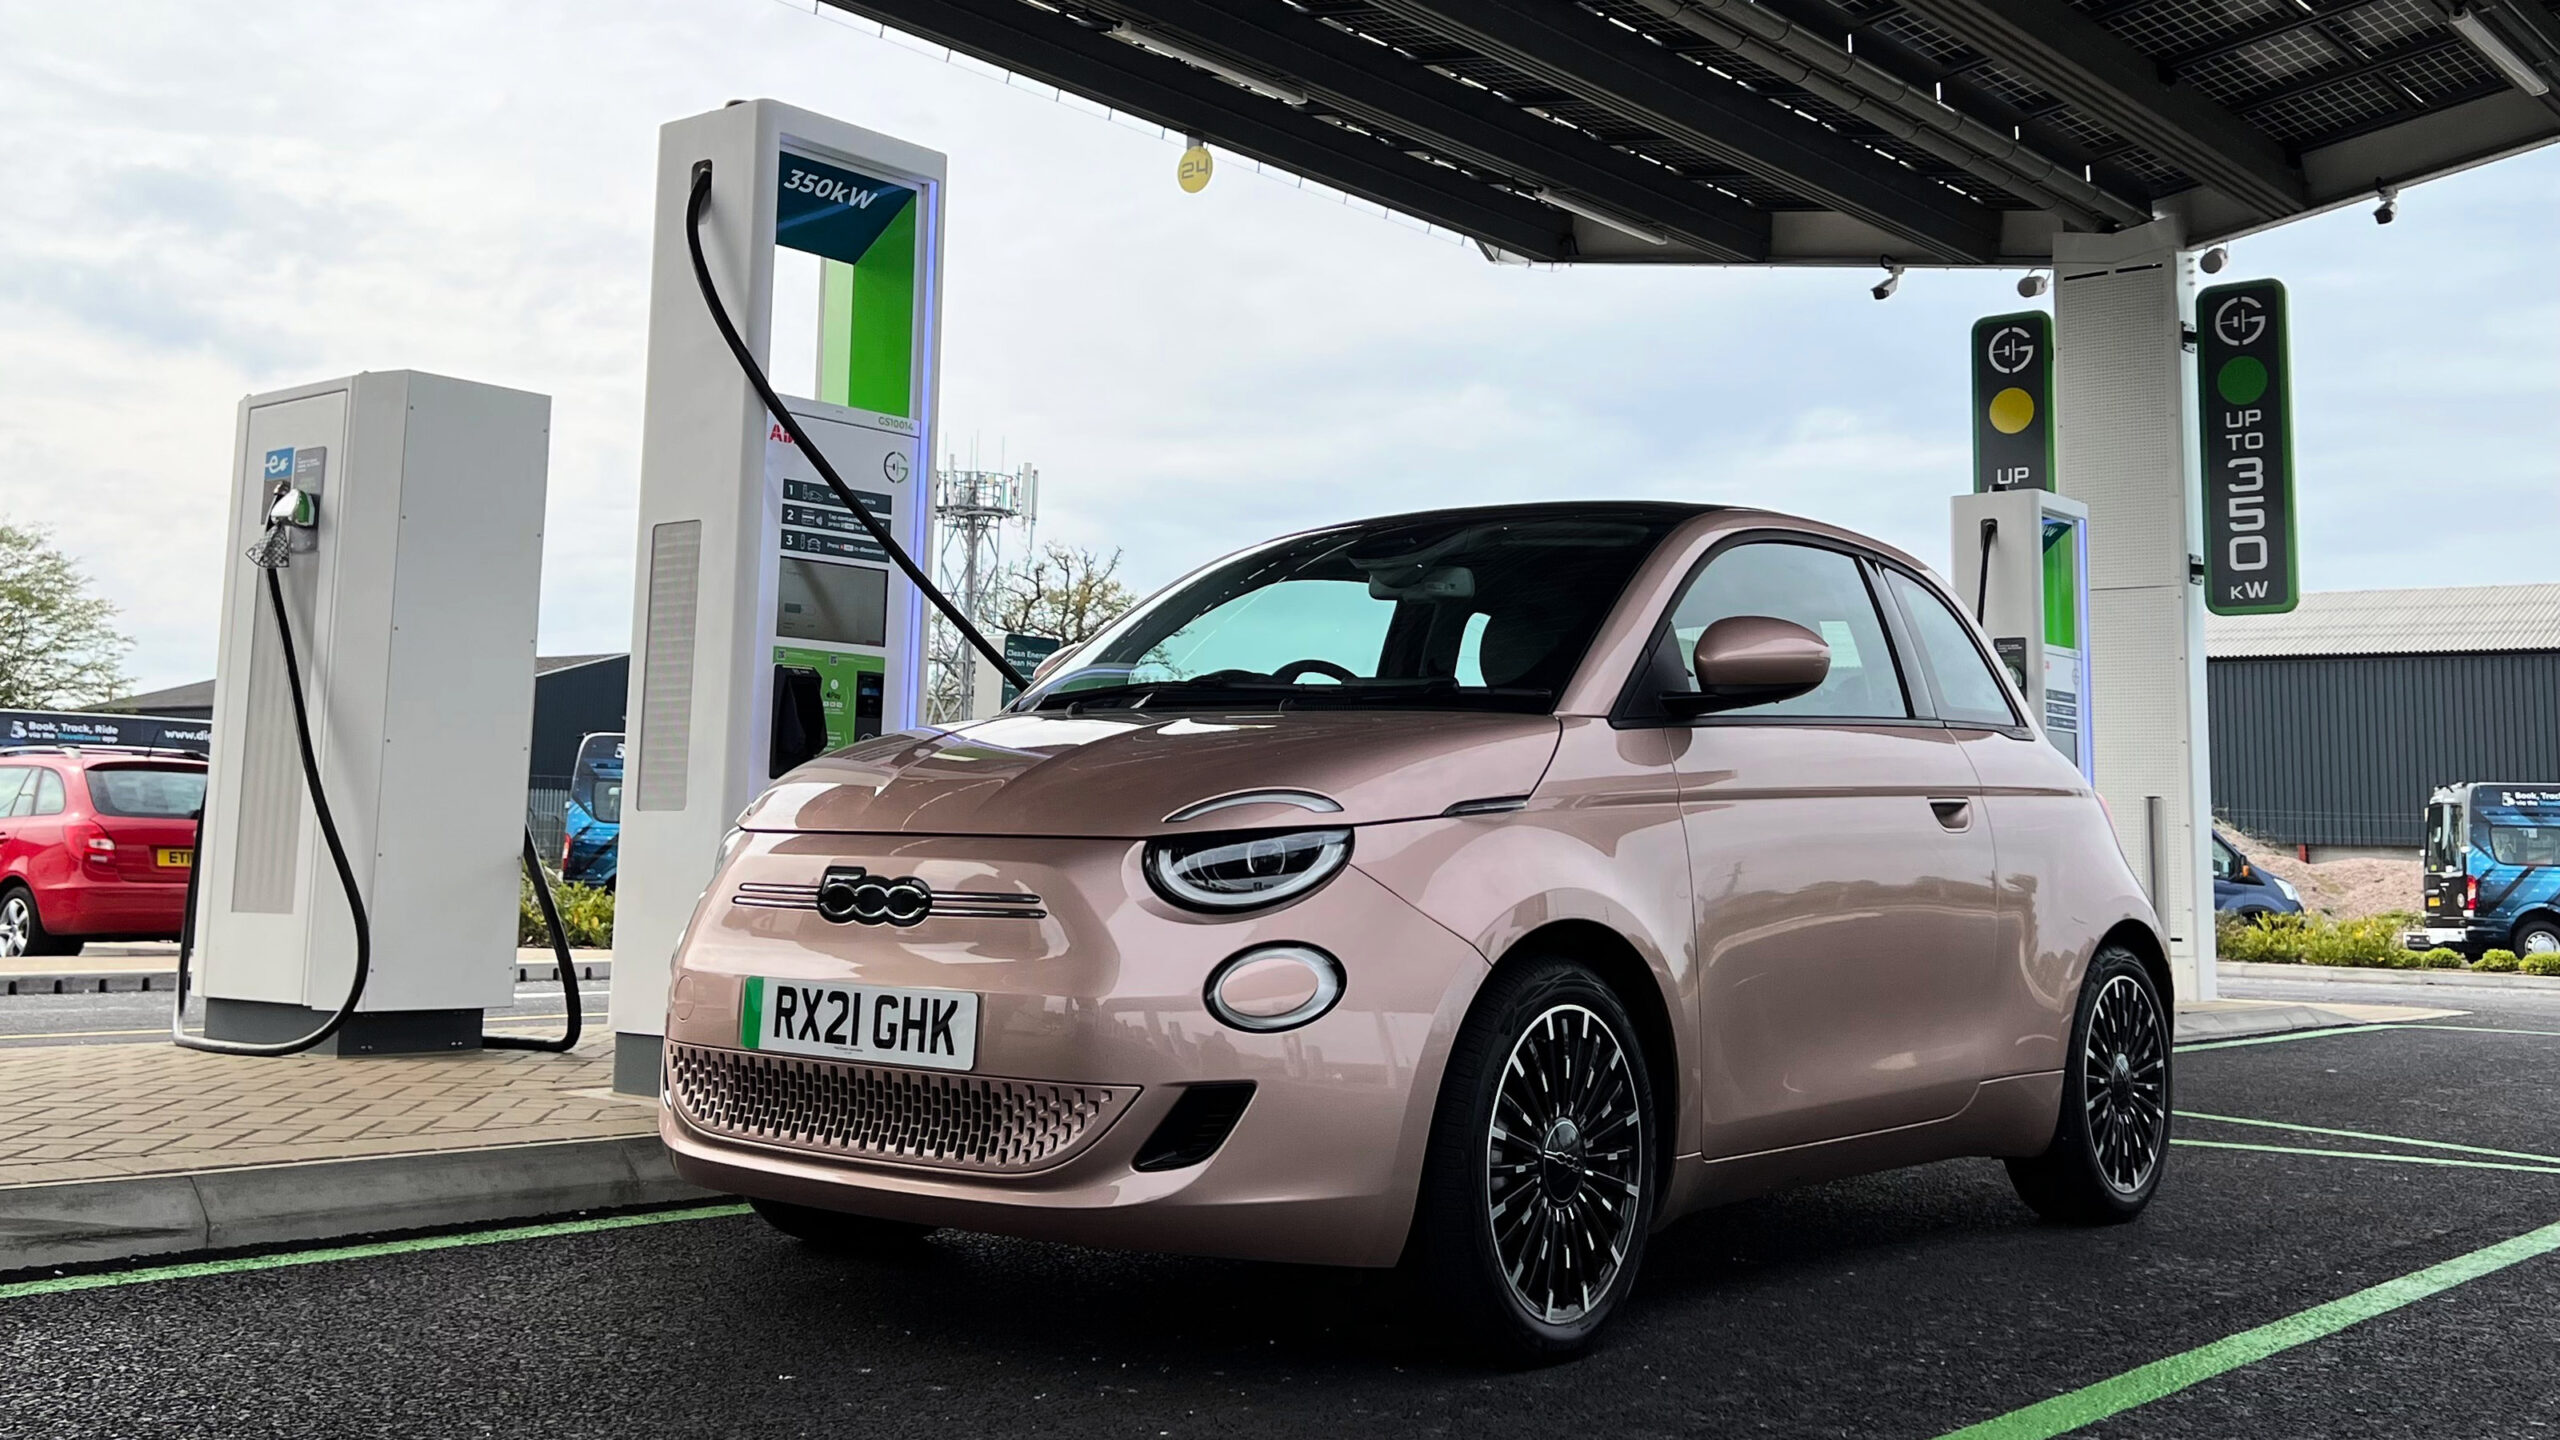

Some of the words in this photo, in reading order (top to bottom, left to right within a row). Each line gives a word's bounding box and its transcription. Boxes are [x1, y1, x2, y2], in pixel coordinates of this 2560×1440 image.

[1181, 159, 1208, 179] 24
[783, 168, 878, 209] 350kW
[878, 416, 913, 431] GS10014
[2225, 409, 2262, 428] UP
[2225, 432, 2264, 450] TO
[1997, 467, 2029, 484] UP
[788, 484, 794, 495] 1
[786, 509, 794, 520] 2
[2227, 456, 2268, 572] 350
[785, 535, 793, 545] 3
[1006, 649, 1026, 658] Clean
[28, 721, 59, 733] Book,
[60, 723, 93, 735] Track,
[95, 725, 119, 735] Ride
[2514, 791, 2540, 800] Book,
[817, 866, 933, 926] 500
[773, 985, 861, 1046] RX21
[872, 994, 959, 1056] GHK
